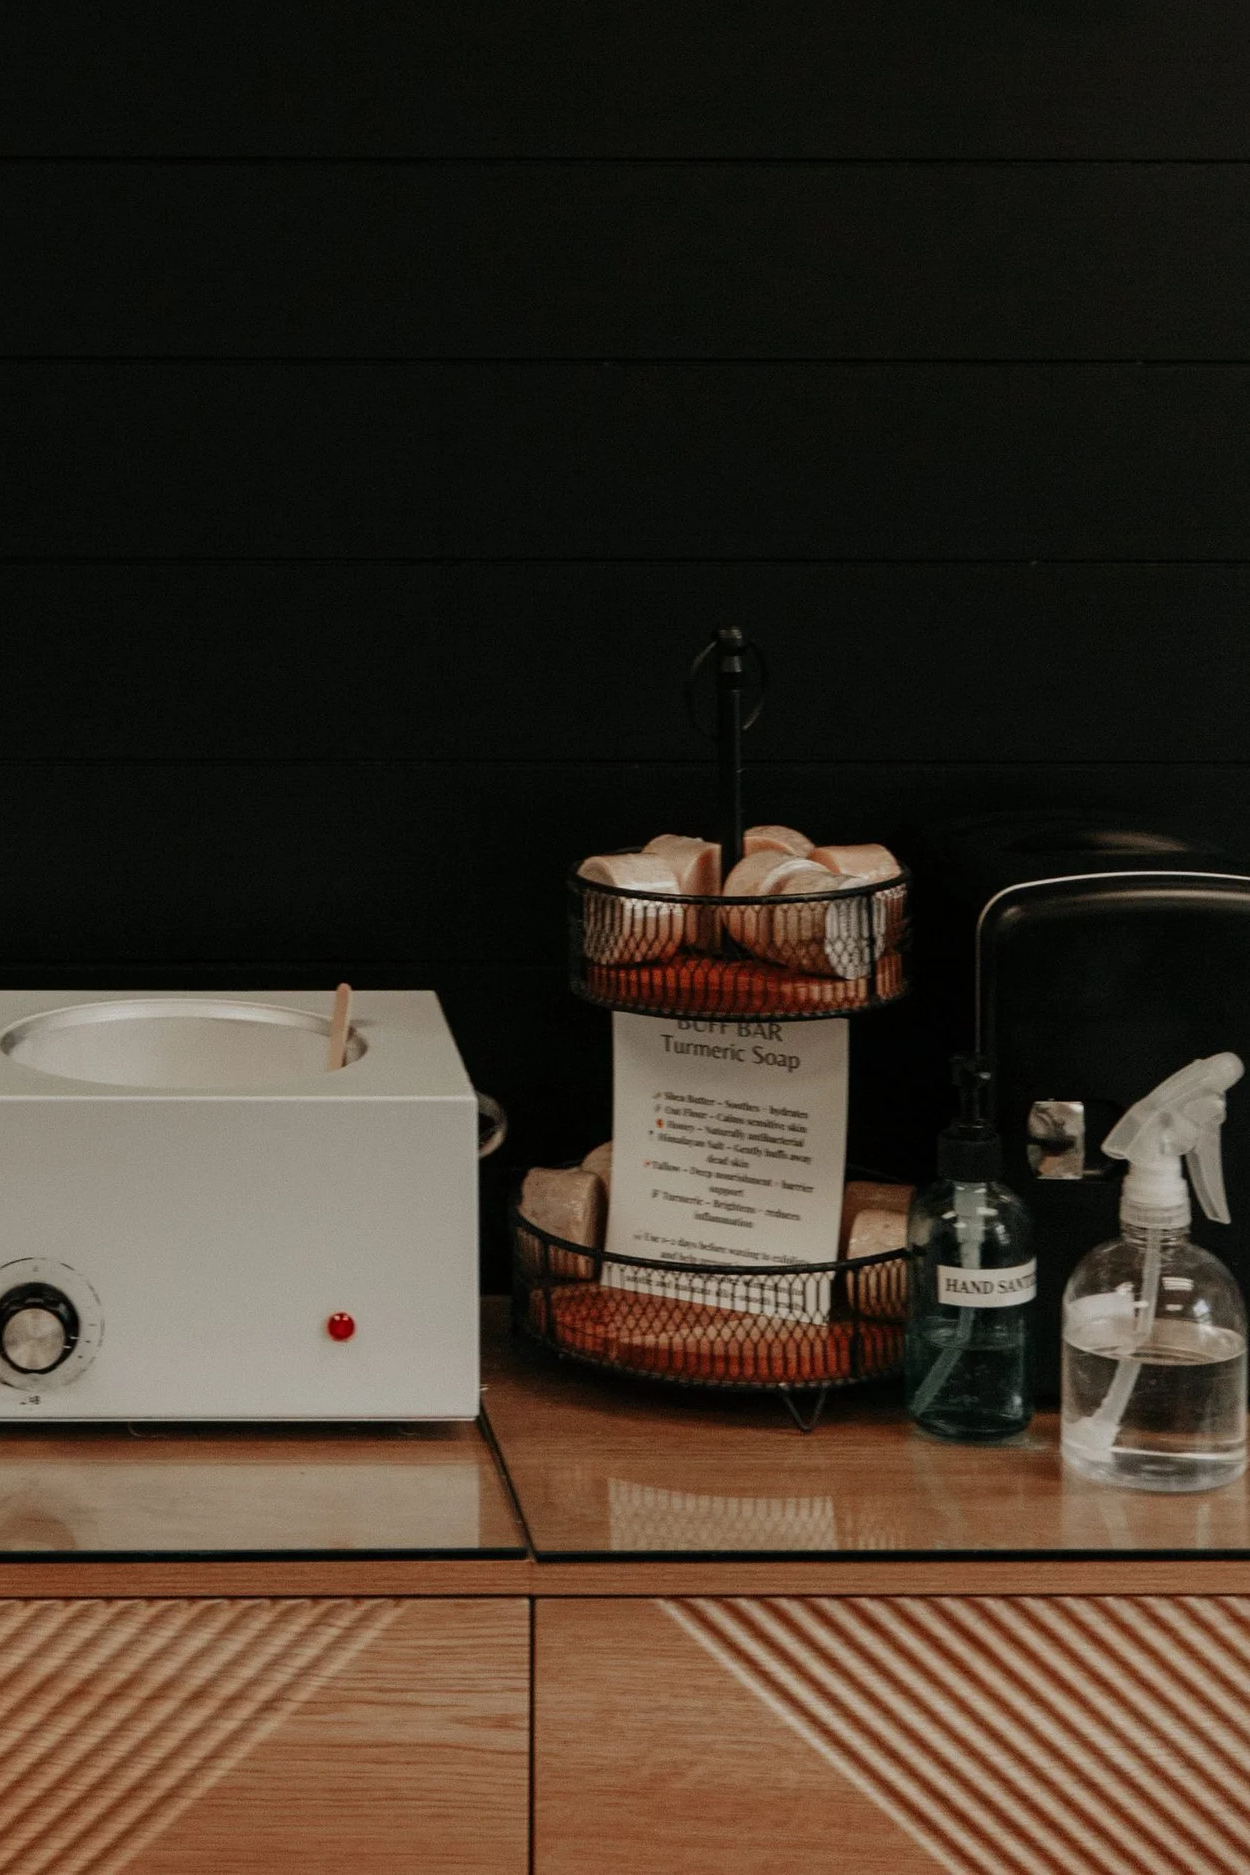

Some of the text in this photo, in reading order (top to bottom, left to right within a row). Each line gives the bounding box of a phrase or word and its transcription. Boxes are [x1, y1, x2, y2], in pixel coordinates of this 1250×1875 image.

[737, 1021, 784, 1042] BAR
[660, 1034, 801, 1073] Turmeric Soap
[945, 1277, 995, 1294] HAND
